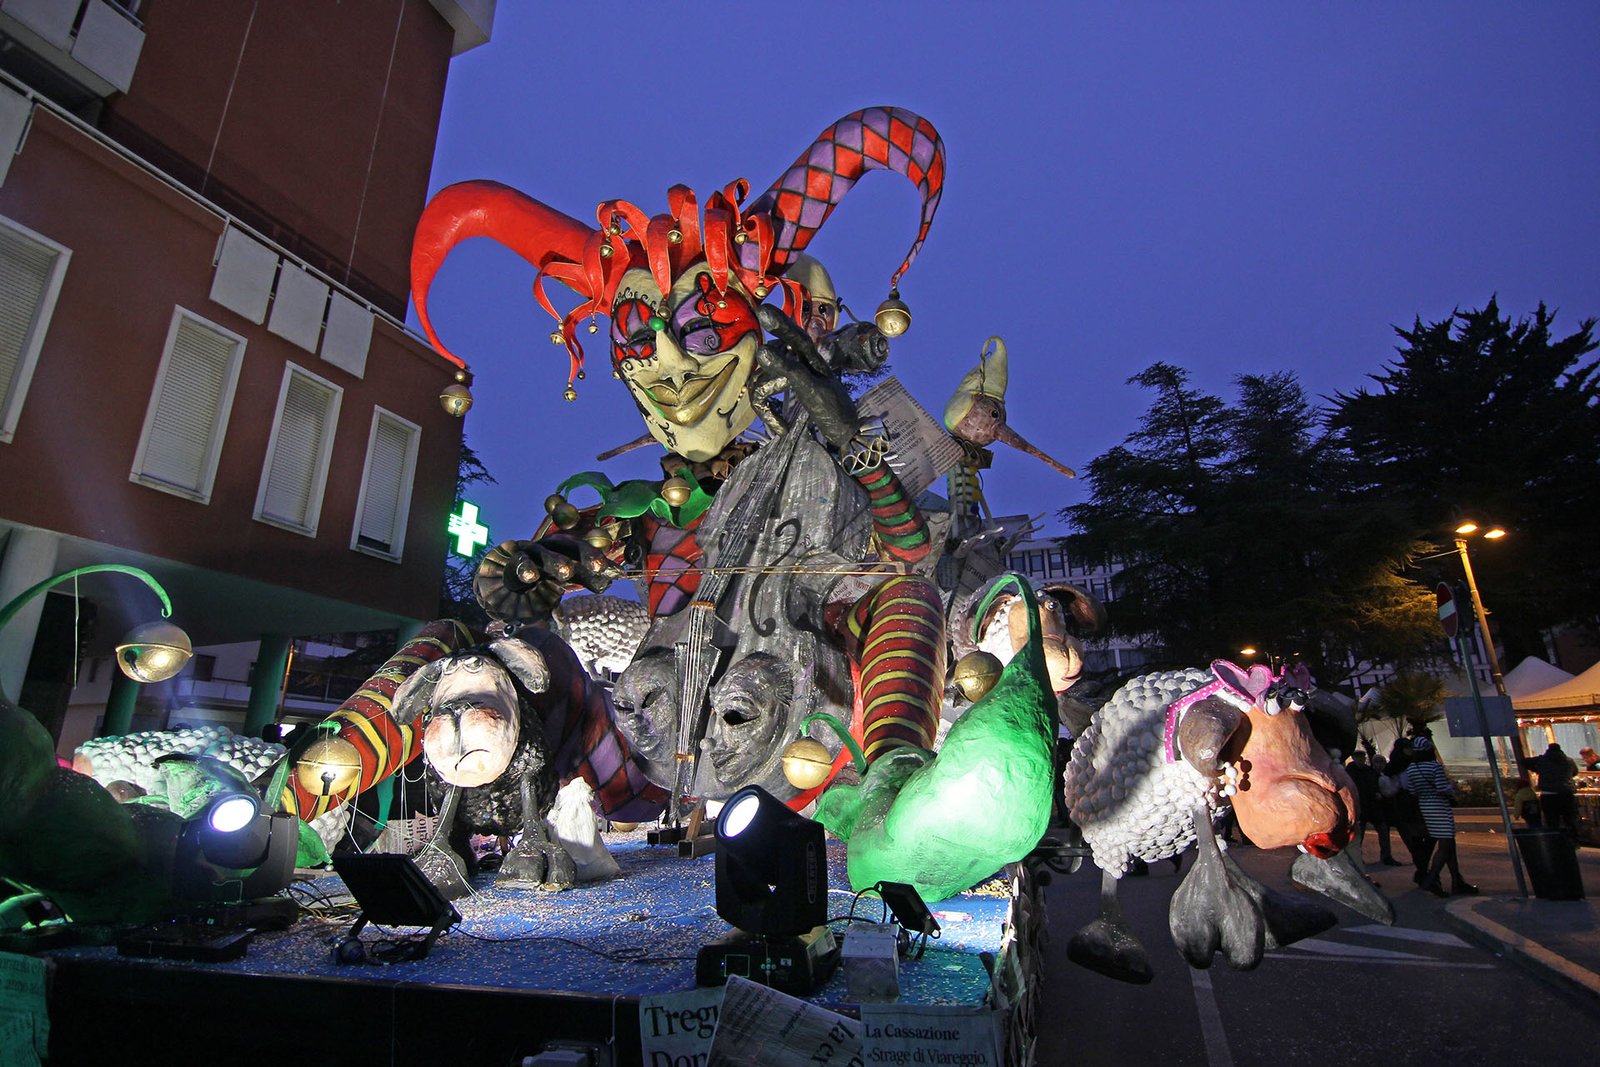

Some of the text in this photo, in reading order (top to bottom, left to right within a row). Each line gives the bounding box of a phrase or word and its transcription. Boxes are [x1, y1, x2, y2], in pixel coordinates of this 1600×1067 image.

[829, 1019, 855, 1043] la
[865, 1024, 960, 1041] La Cassazione
[913, 1047, 924, 1063] di
